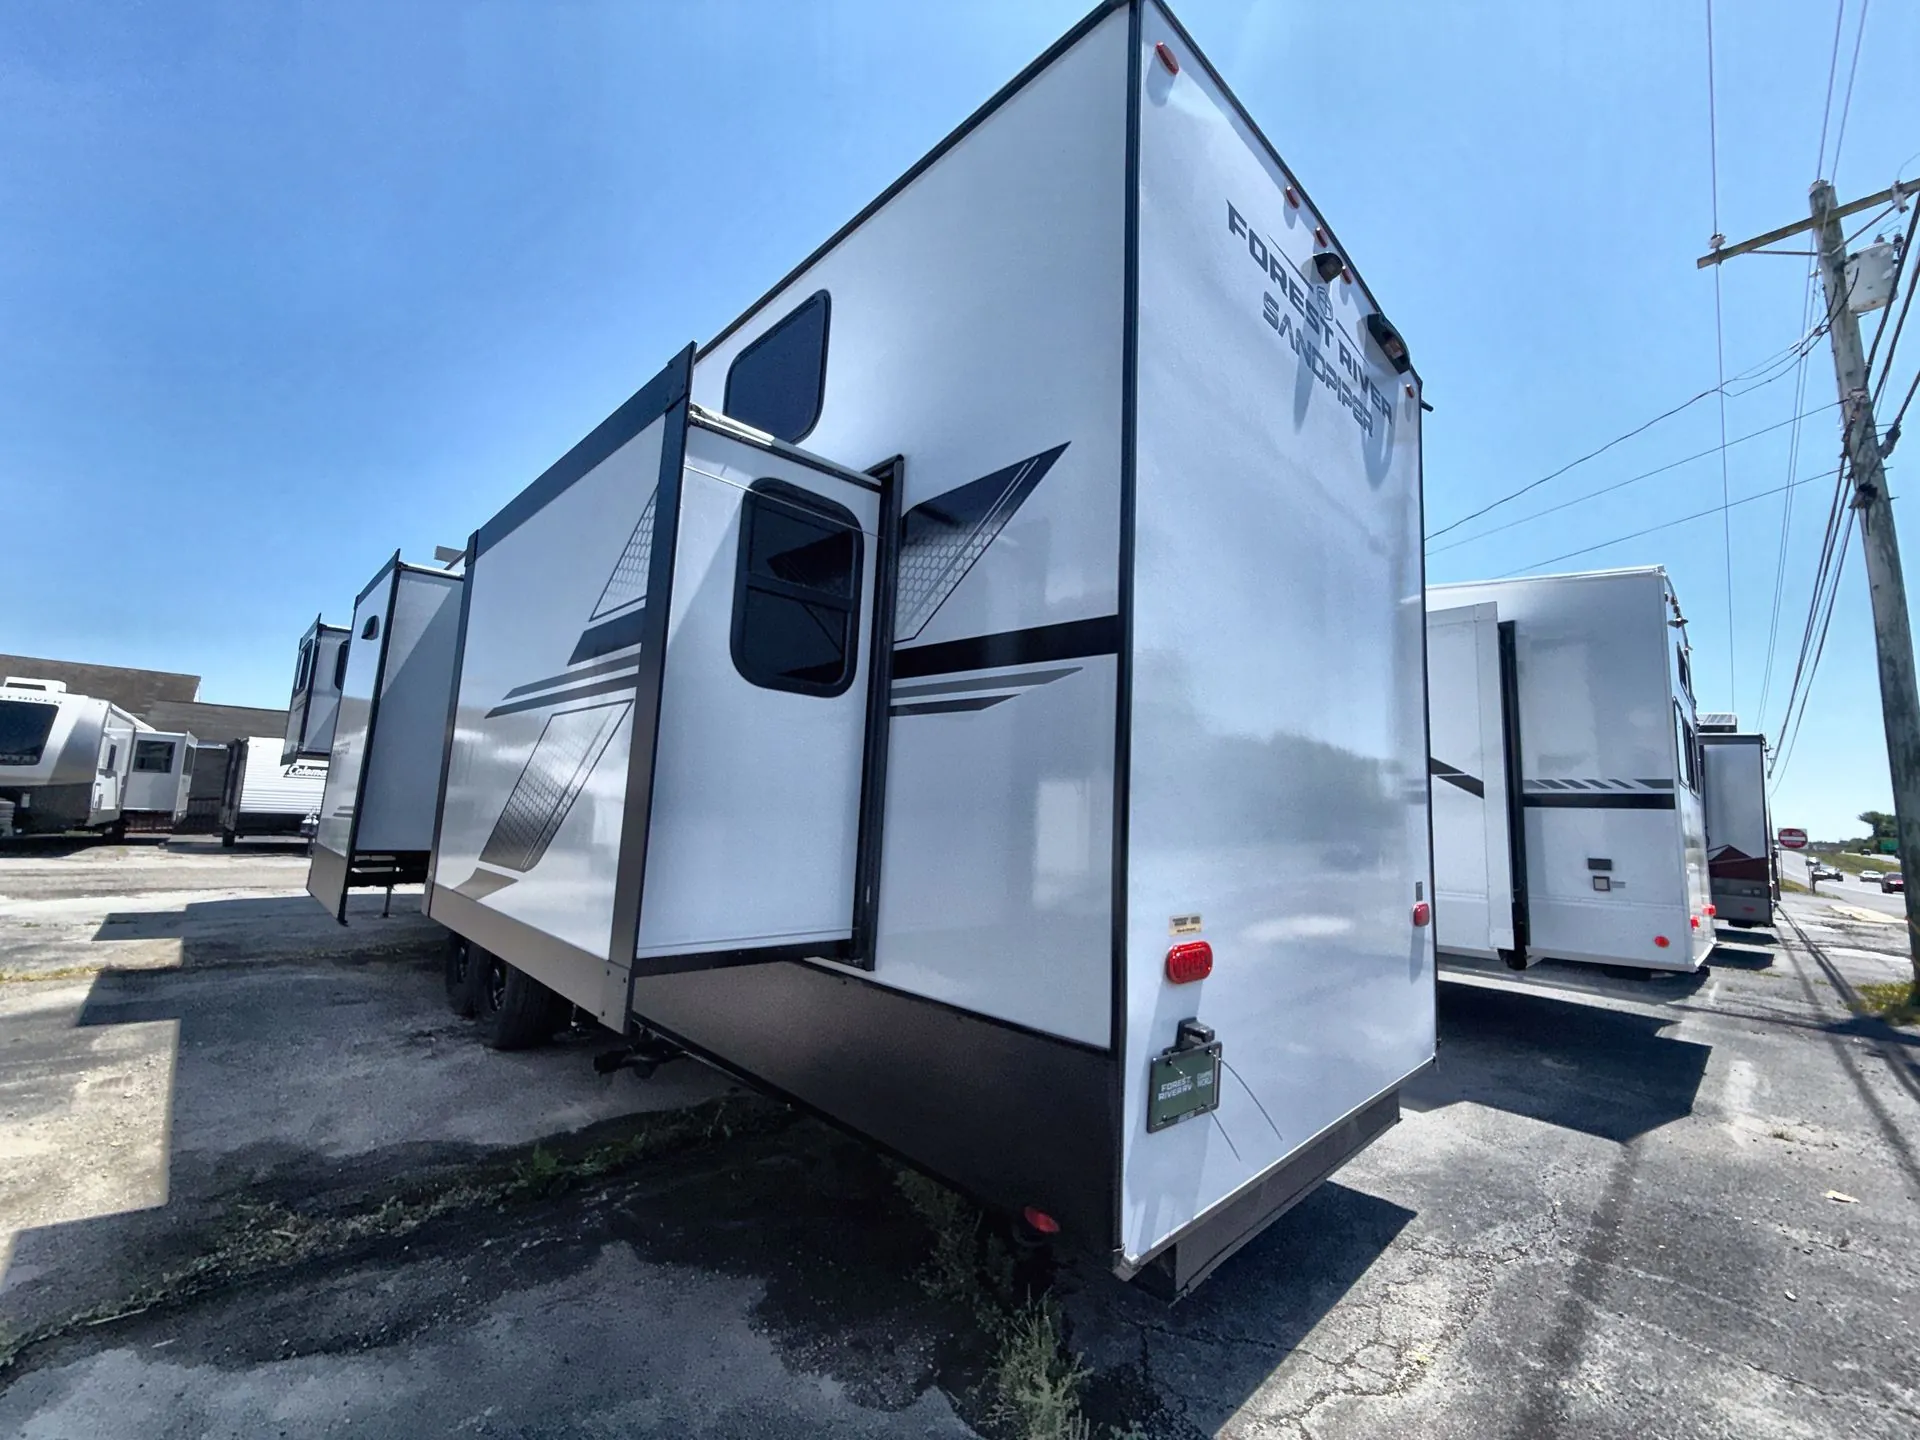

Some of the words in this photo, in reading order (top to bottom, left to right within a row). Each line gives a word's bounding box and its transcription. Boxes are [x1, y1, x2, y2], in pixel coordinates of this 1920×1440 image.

[1226, 198, 1335, 348] FOREST
[1337, 339, 1393, 425] RIVER
[1262, 290, 1374, 438] SANDPIPER
[289, 765, 328, 777] Colema
[1161, 1075, 1192, 1092] FOREST
